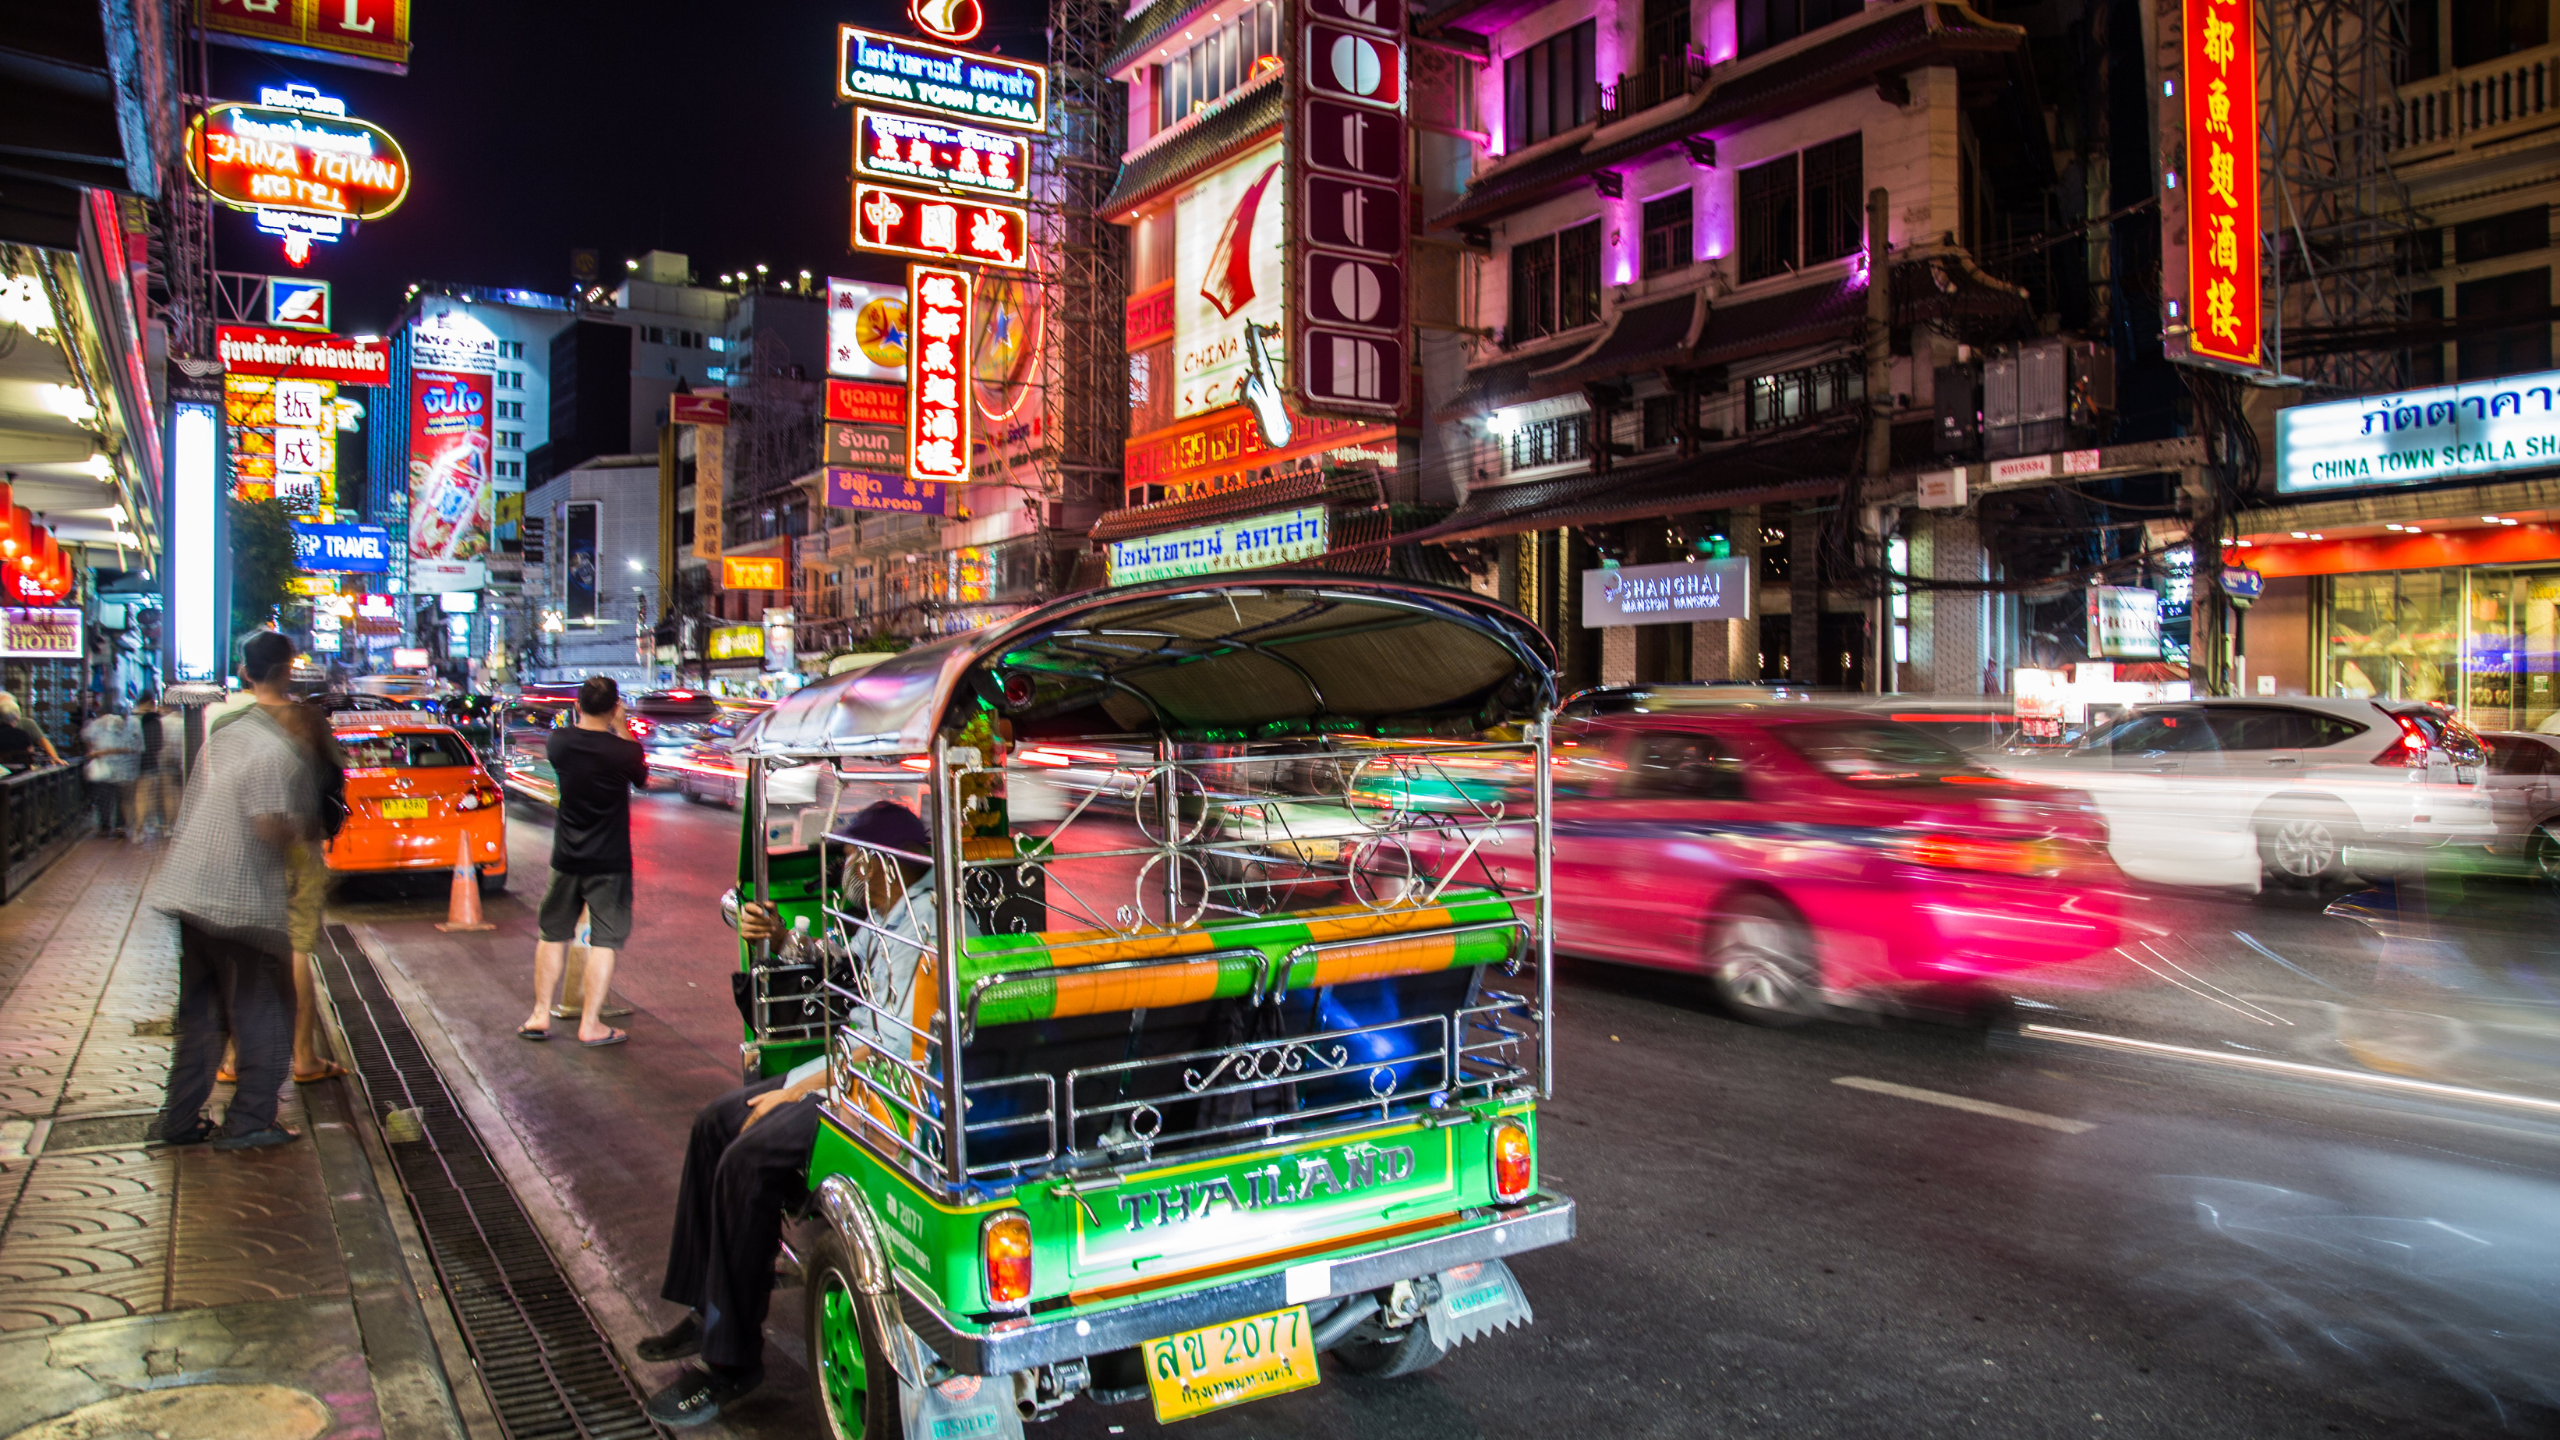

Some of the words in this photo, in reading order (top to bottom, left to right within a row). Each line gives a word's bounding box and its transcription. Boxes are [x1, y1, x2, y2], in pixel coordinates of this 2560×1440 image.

[851, 70, 913, 99] CHINA
[916, 82, 973, 110] TOWN
[976, 93, 1037, 121] SCALA
[309, 147, 397, 190] TOWN
[2203, 0, 2242, 346] 都魚翅酒樓
[1184, 337, 1238, 373] CHINA
[839, 387, 898, 409] หูฉลาม
[2361, 386, 2560, 435] ภัตตาคา
[850, 406, 898, 421] SHARK
[838, 427, 889, 450] รังนก
[850, 449, 886, 464] BIRD
[2312, 457, 2370, 481] CHINA
[2378, 447, 2435, 473] TOWN
[2442, 440, 2516, 466] SCALA
[2526, 434, 2560, 457] SH
[851, 494, 923, 512] SEAFOOD
[323, 534, 384, 560] TRAVEL
[1622, 573, 1721, 599] SHANGHAI
[1621, 597, 1669, 614] MANSION
[1673, 593, 1721, 610] BANGKOK
[11, 633, 77, 652] HOTEL
[1117, 1144, 1415, 1232] THAILAND
[1154, 1333, 1207, 1380] สข
[1220, 1311, 1300, 1365] 2077
